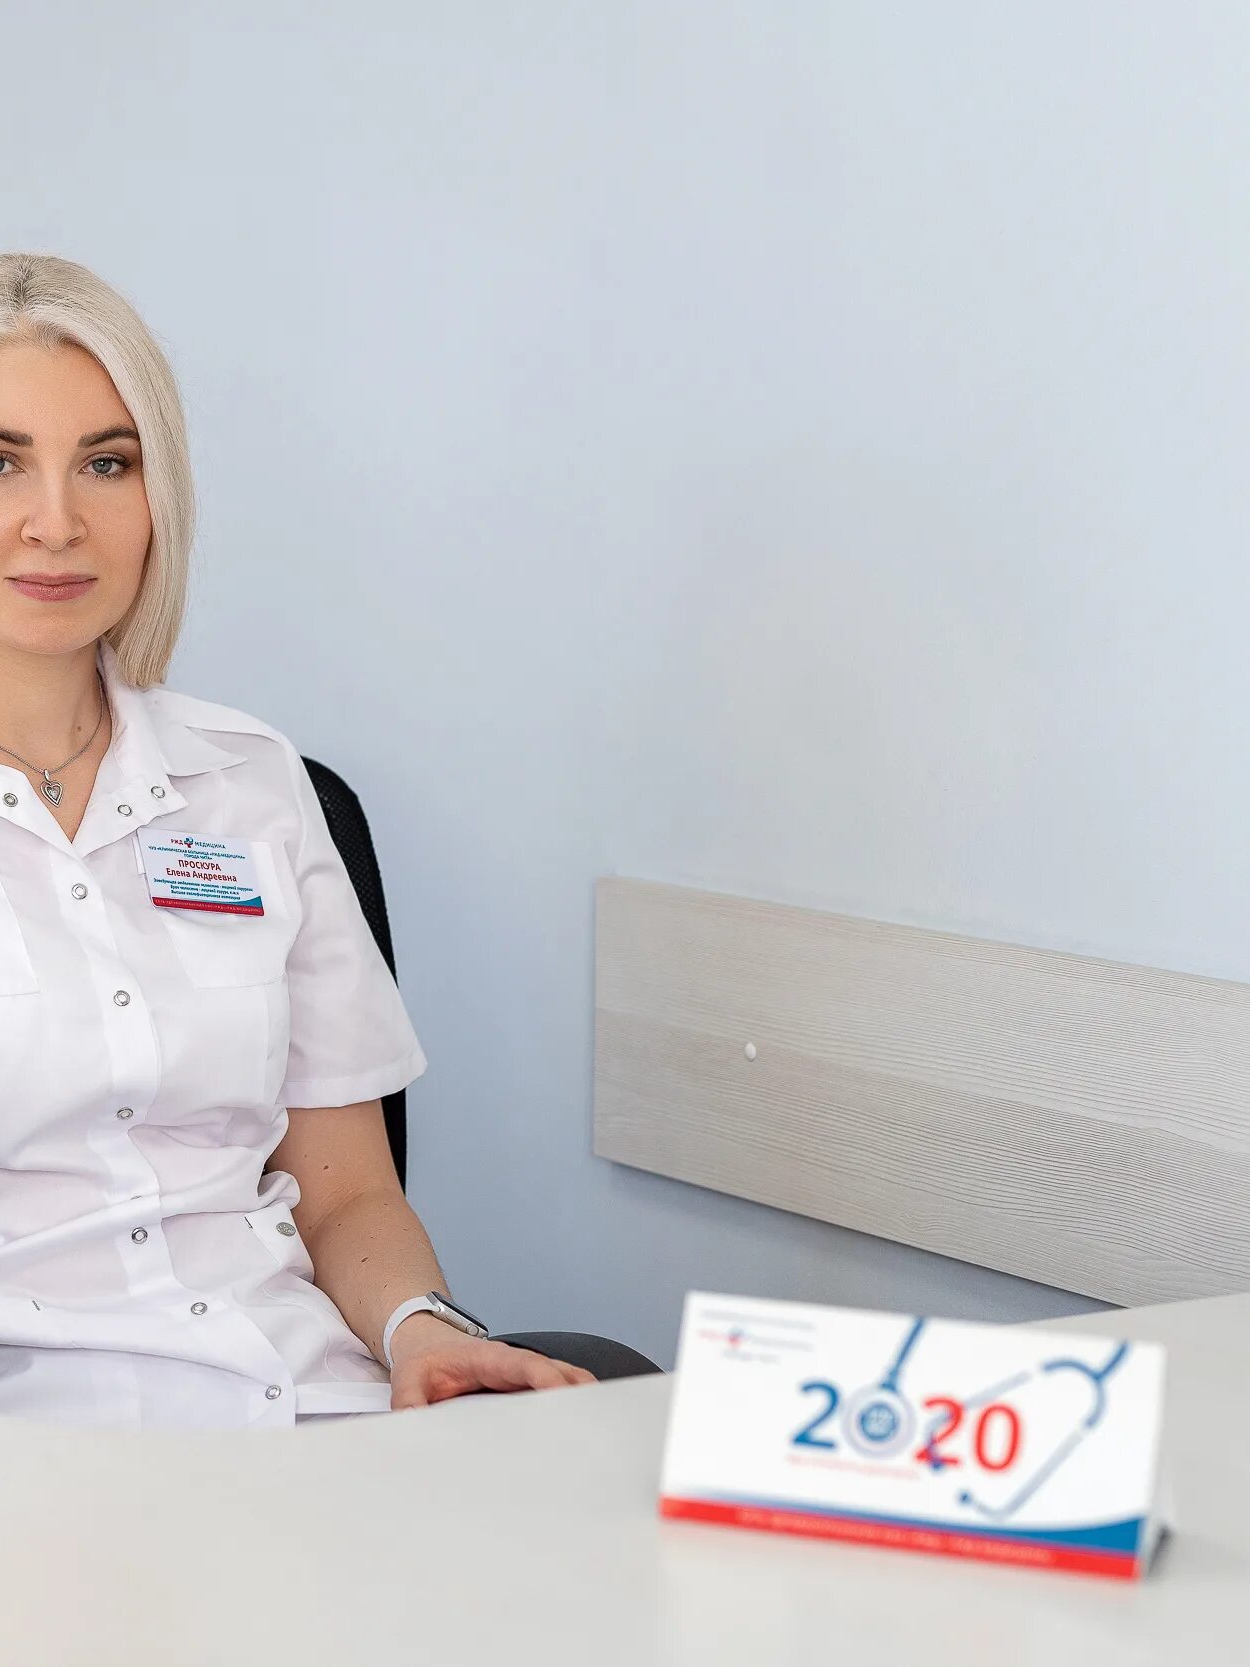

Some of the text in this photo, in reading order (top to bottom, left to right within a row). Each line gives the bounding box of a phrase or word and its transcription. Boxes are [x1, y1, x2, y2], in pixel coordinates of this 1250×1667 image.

[178, 859, 222, 871] ПРОСКУРА
[166, 867, 238, 882] Елена Андреевна
